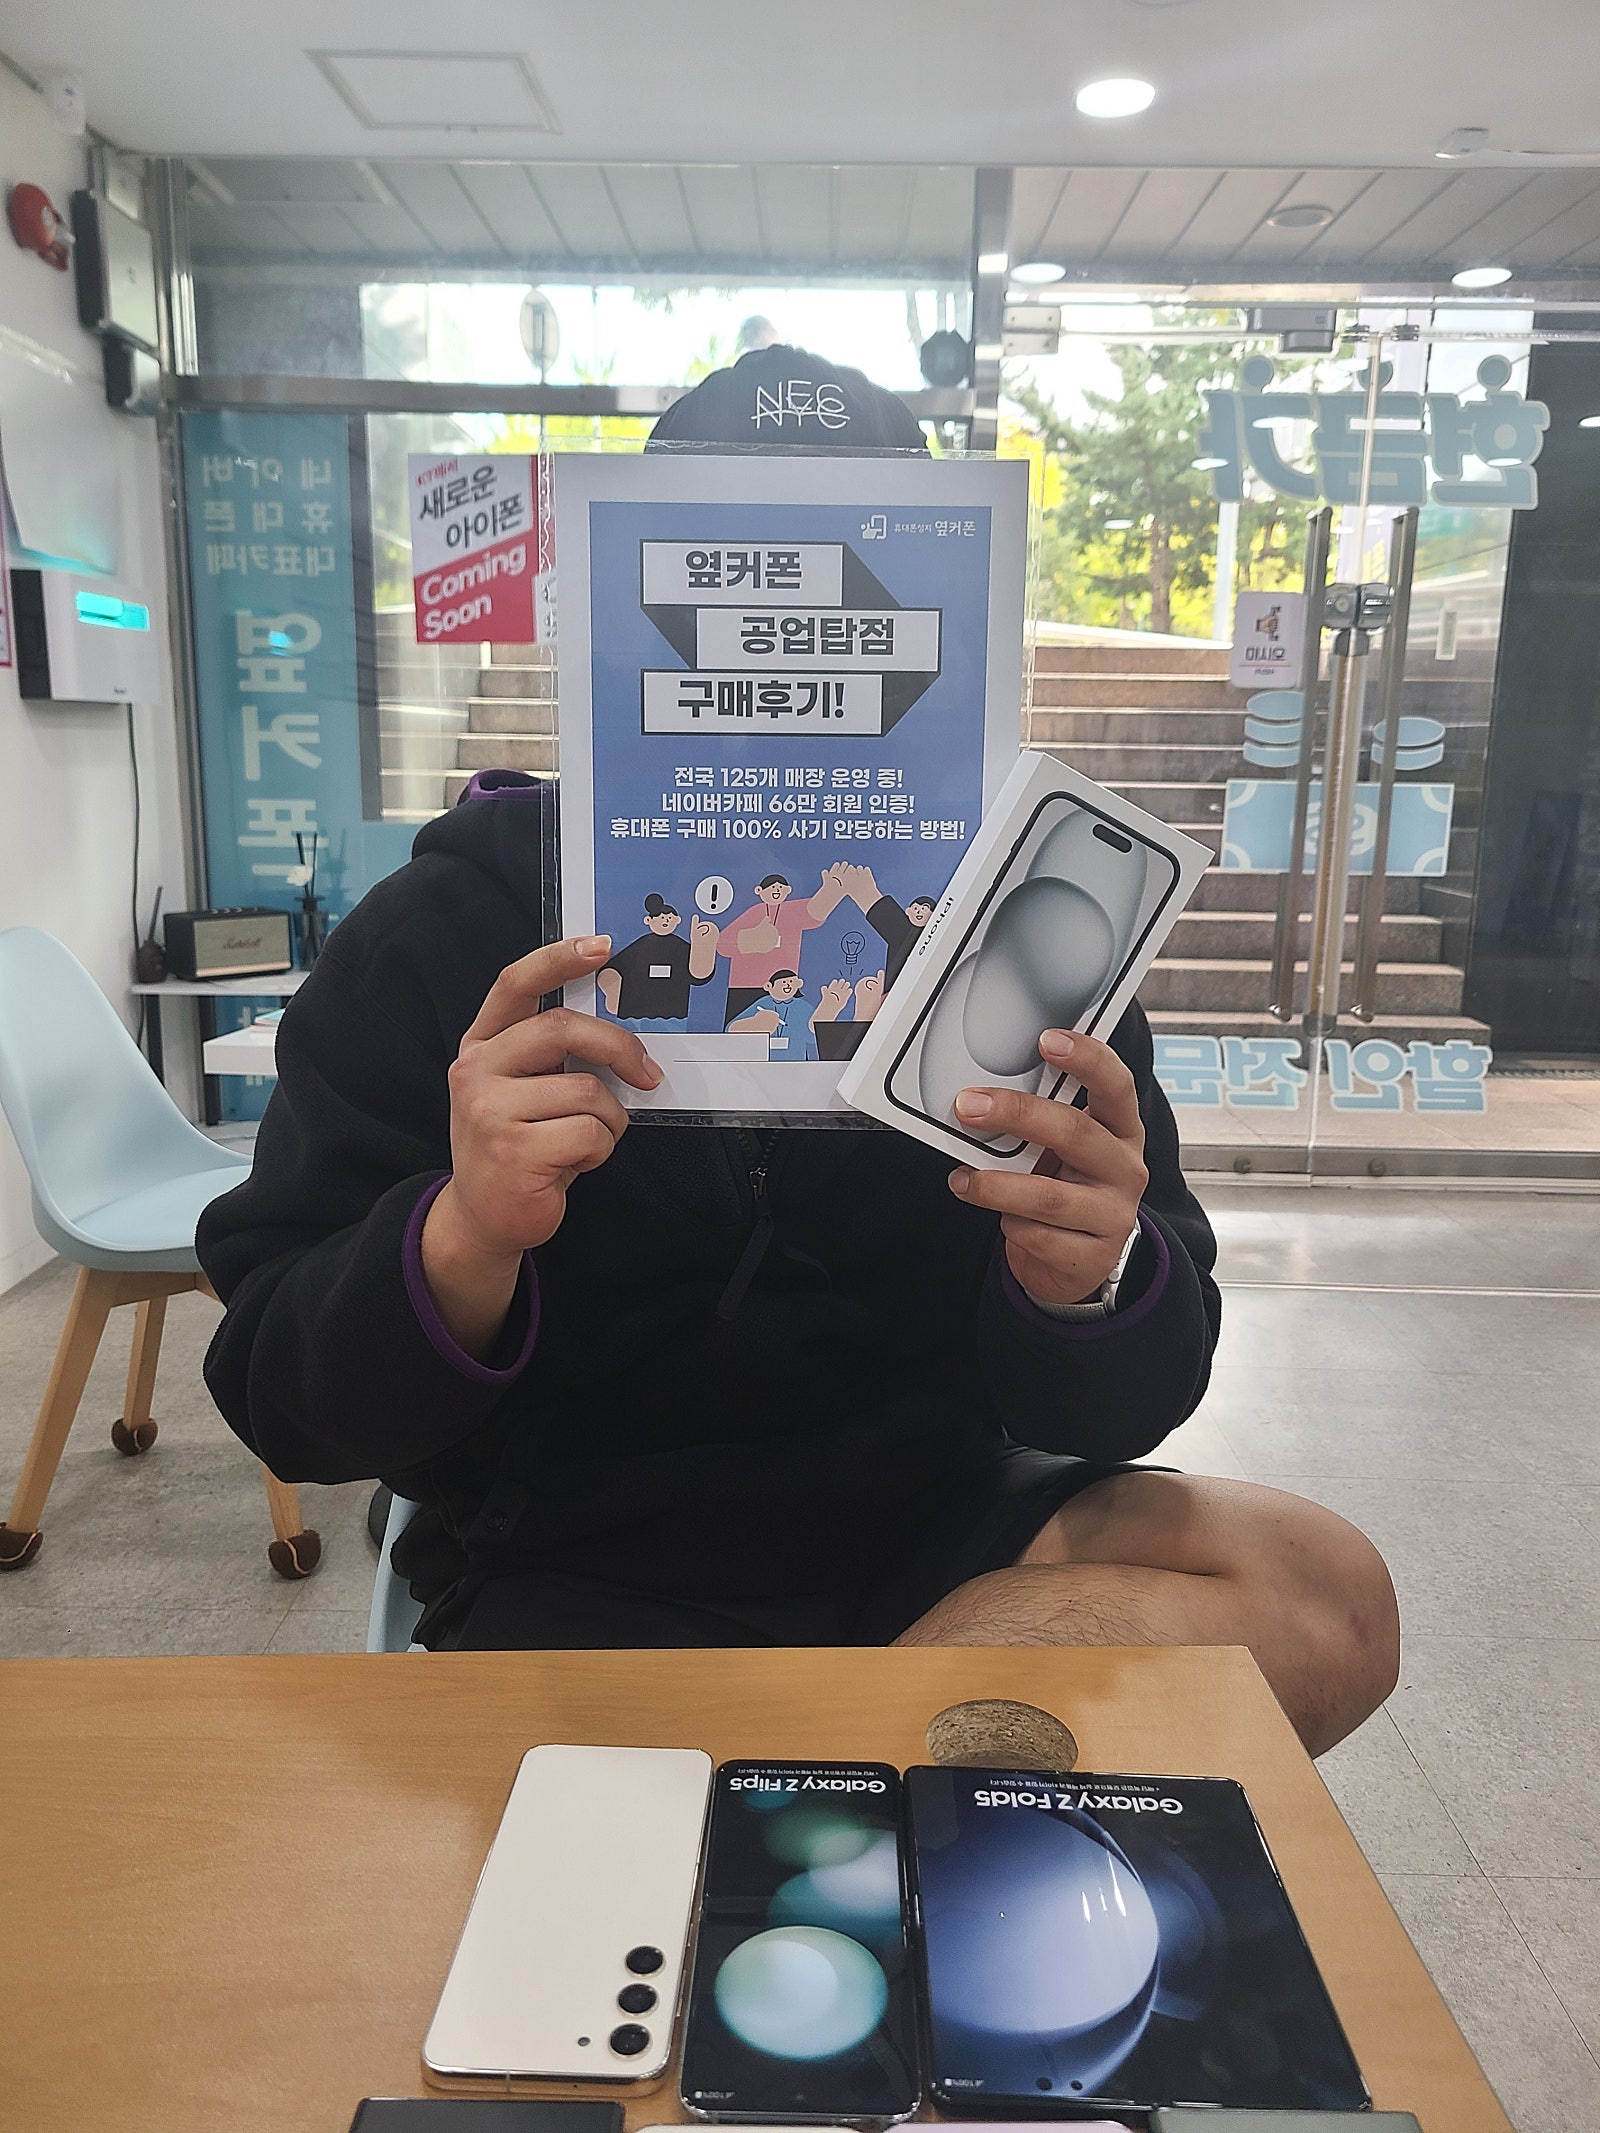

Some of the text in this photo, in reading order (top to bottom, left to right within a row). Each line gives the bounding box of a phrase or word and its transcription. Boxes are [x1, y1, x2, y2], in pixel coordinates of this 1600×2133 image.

[417, 464, 497, 520] 새로운
[446, 492, 525, 549] 아이폰
[935, 520, 976, 537] 옆커폰
[421, 543, 527, 605] Coming
[685, 549, 802, 590] 옆커폰
[423, 594, 492, 639] Soon
[739, 615, 896, 657] 공업탑점
[677, 679, 845, 719] 구매후기!
[674, 767, 903, 789] 전국 125개 매장 운영 중!
[661, 793, 915, 815] 네이버카페 66만 회원 인증!
[610, 817, 966, 841] 휴대폰 구매 100% 사기 안당하는 방법!
[729, 1775, 886, 1794] Galaxy Z Flip5
[974, 1789, 1184, 1816] Galaxy Z Fold5
